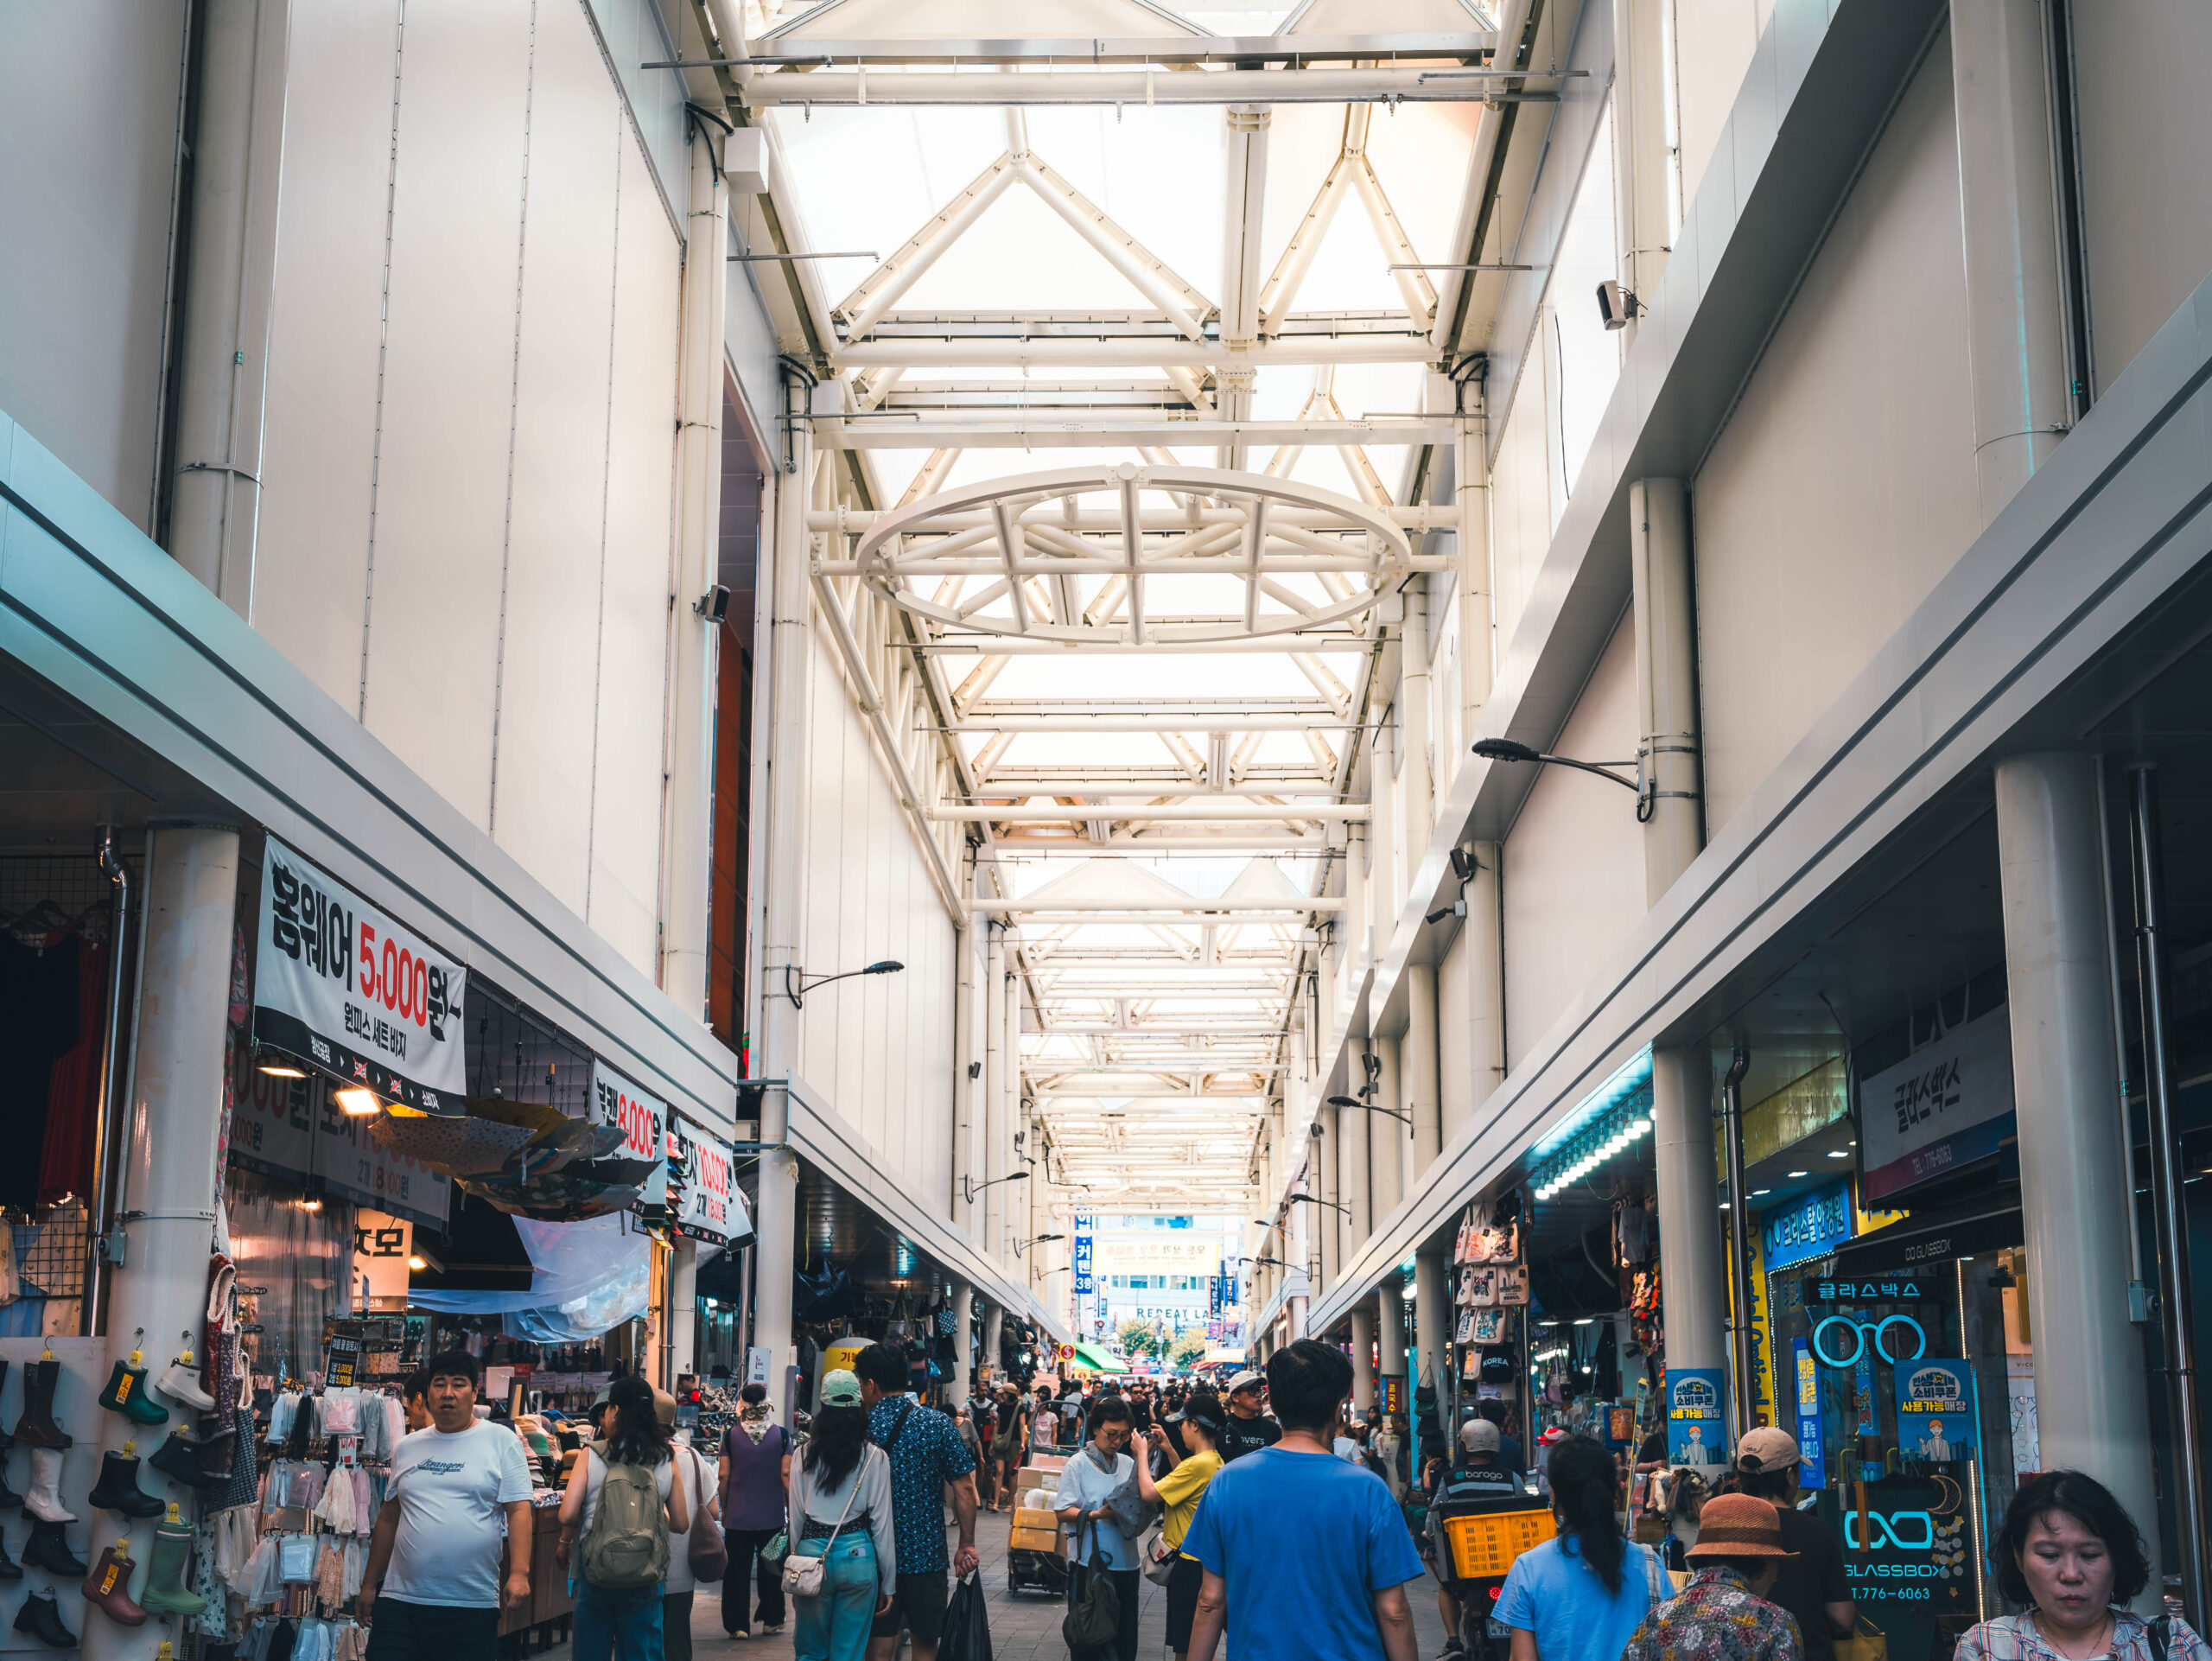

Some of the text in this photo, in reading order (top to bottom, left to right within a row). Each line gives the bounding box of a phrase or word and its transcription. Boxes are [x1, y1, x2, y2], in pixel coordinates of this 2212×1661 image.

[273, 862, 353, 993] 홈웨어
[345, 1002, 407, 1062] 원피스 세트 바지
[1894, 1057, 1961, 1134] 글라스박스
[696, 1193, 708, 1218] 2개
[1077, 1276, 1092, 1290] 3층
[1818, 1282, 1921, 1299] 글라스박스
[1483, 1357, 1510, 1367] KOREA
[1913, 1387, 1957, 1398] 소비쿠폰
[1677, 1396, 1714, 1406] 소비쿠폰
[418, 1455, 466, 1472] Strangers
[1465, 1470, 1503, 1480] barogo
[1843, 1564, 1955, 1577] GLASSBOX
[1851, 1588, 1939, 1600] T.776-6063
